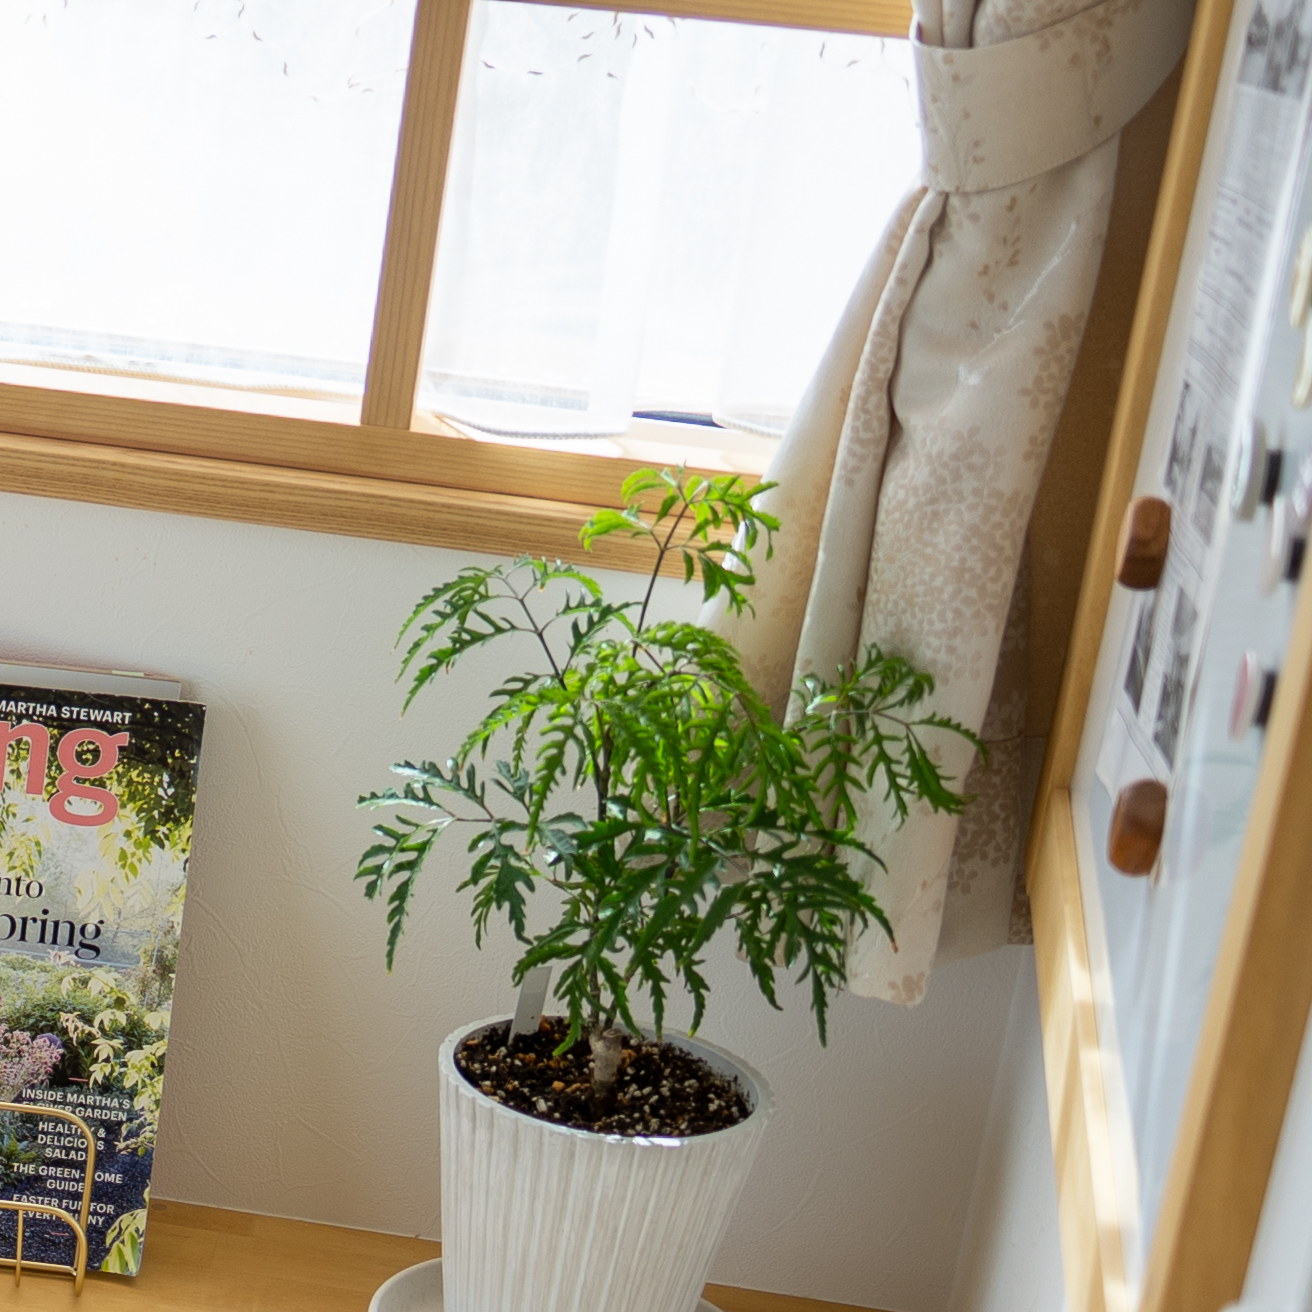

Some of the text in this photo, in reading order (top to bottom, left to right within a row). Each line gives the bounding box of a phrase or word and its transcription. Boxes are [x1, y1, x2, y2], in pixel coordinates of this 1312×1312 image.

[60, 706, 132, 725] STEWART
[22, 1088, 130, 1109] INSIDE MARTHA'S
[76, 1107, 128, 1121] GARDEN
[38, 1121, 106, 1138] HEALT &
[37, 1134, 105, 1150] DELICIOS
[44, 1147, 87, 1160] SALAD
[13, 1163, 124, 1184] THE GREEN-OME
[46, 1179, 85, 1192] GUIDE
[89, 1202, 115, 1214] FOR
